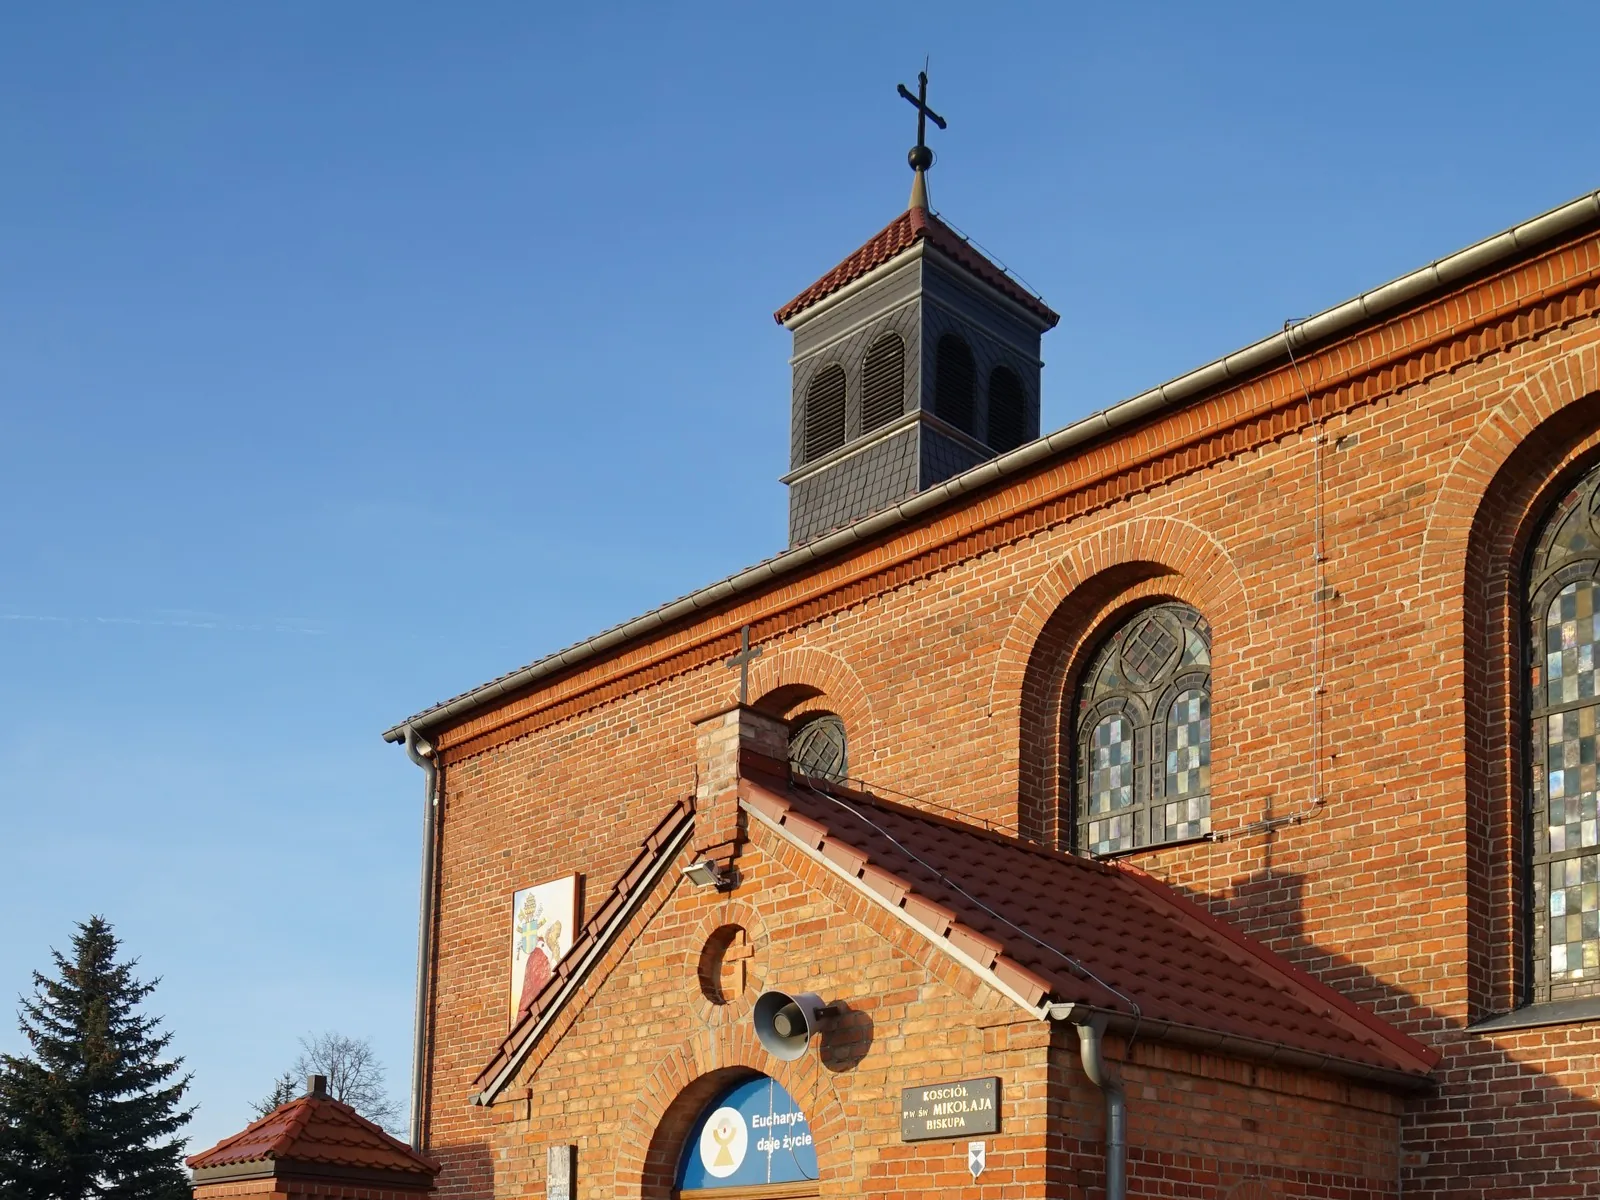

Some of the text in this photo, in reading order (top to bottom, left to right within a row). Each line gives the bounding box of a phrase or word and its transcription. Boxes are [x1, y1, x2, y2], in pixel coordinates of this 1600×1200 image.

[933, 1098, 992, 1116] MIKOŁAJA
[752, 1111, 806, 1128] Eucharys
[926, 1117, 966, 1130] BISKUPA
[757, 1132, 812, 1154] daje życie
